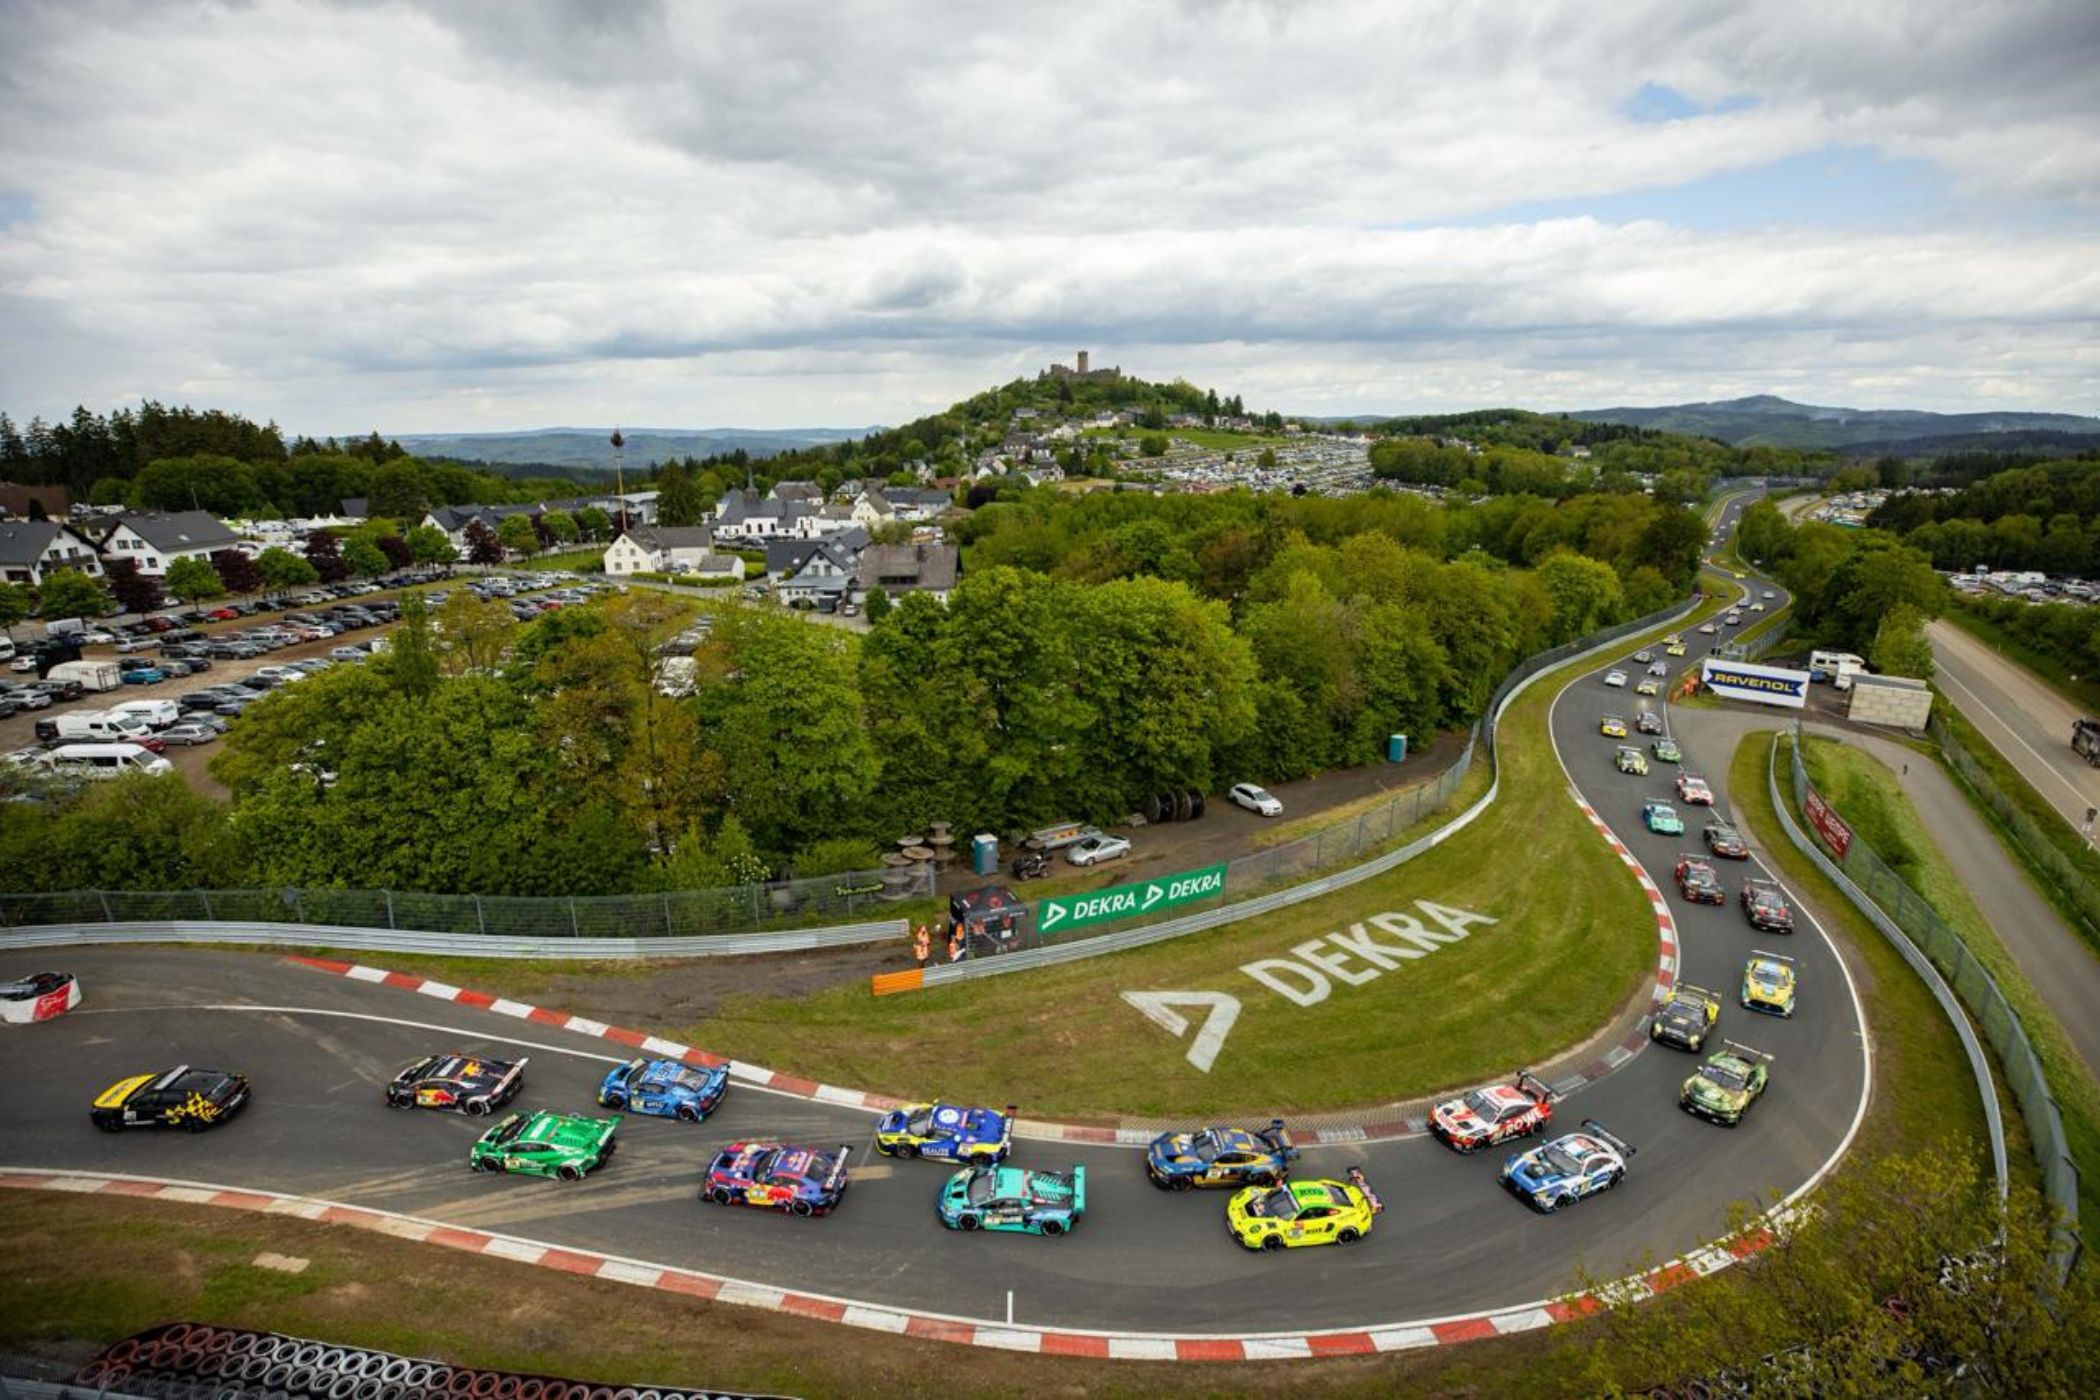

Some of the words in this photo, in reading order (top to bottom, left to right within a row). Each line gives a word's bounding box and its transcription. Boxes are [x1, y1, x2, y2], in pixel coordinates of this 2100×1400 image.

[1714, 673, 1796, 692] RAVENOL
[1168, 872, 1222, 901] DEKRA
[1072, 892, 1135, 920] DEKRA
[1238, 898, 1499, 1007] DEKRA
